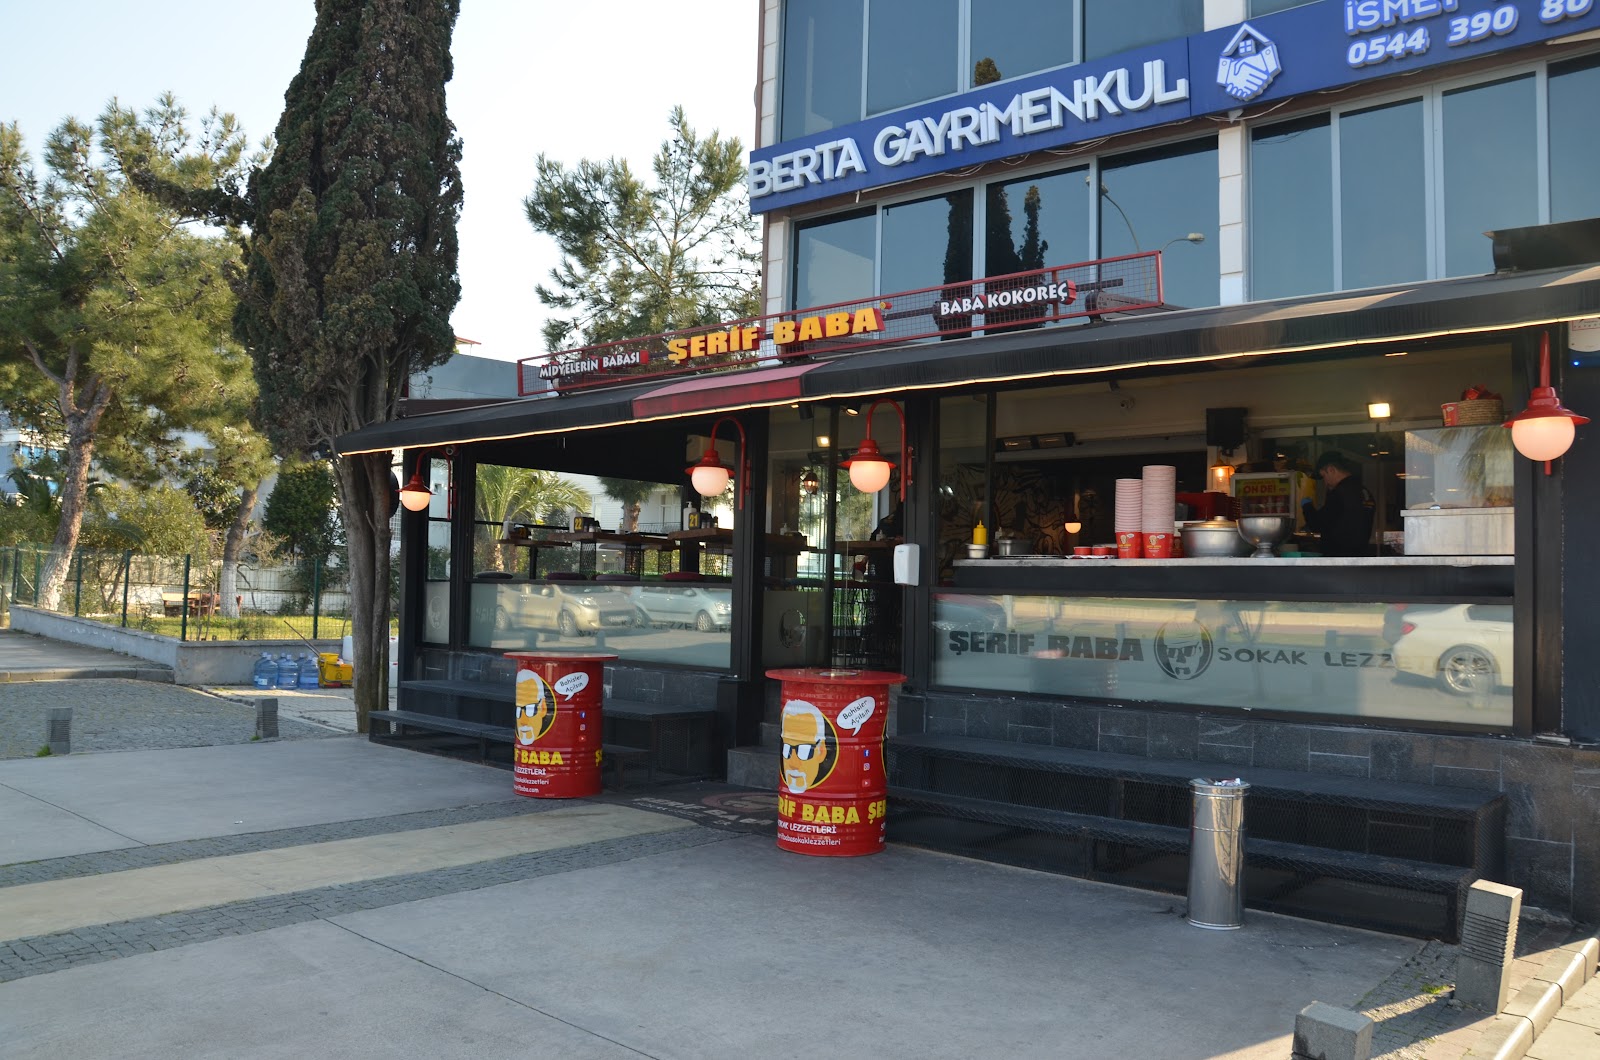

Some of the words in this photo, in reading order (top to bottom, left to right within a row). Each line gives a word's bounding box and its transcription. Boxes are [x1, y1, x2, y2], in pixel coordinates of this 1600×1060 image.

[1348, 26, 1430, 66] 0544
[1447, 4, 1519, 43] 390
[748, 137, 867, 199] BERTA
[939, 295, 985, 317] BABA
[987, 283, 1069, 308] KOKOREÇ
[667, 325, 759, 366] ŞERİF
[773, 307, 882, 345] BABA
[539, 358, 598, 379] MİDYELERİN
[602, 351, 640, 369] BABASI
[949, 629, 1035, 656] ŞERİF
[1047, 634, 1145, 662] BABA
[1217, 646, 1309, 666] SOKAK
[520, 749, 564, 766] BABA
[789, 823, 837, 834] LEZZETLERİ
[802, 803, 861, 825] BABA
